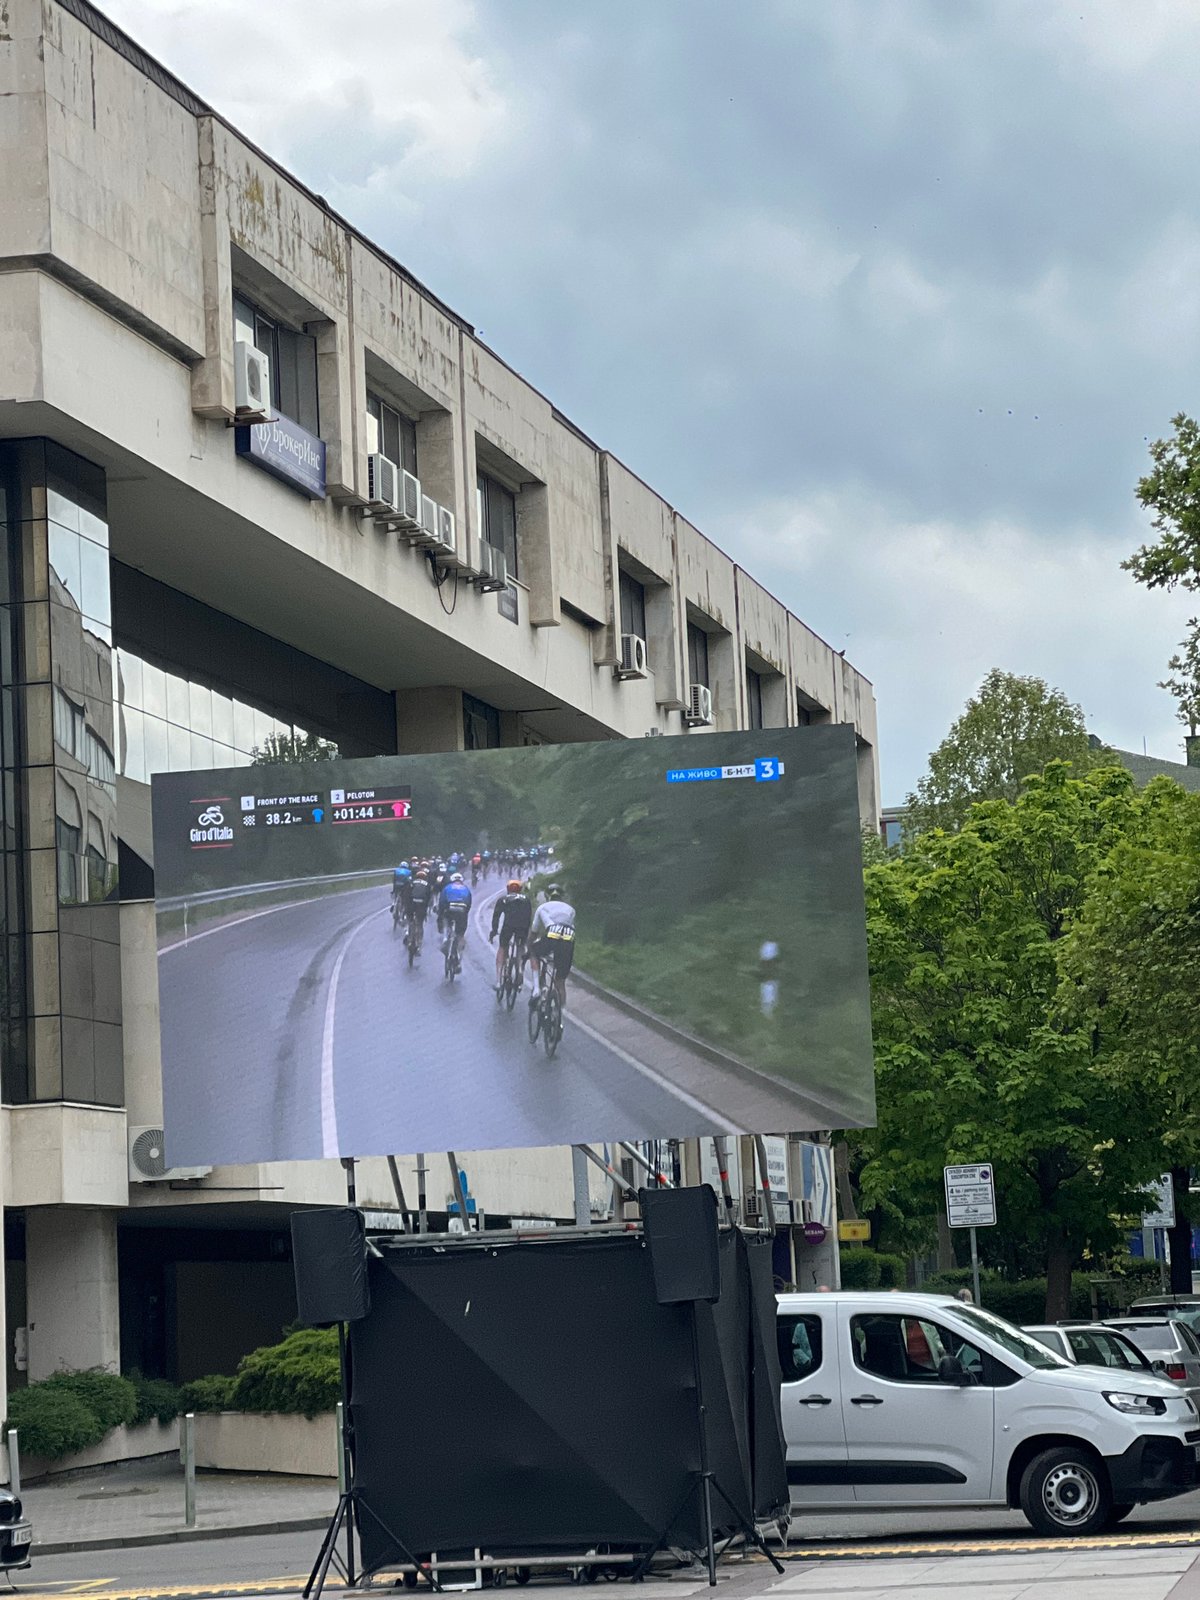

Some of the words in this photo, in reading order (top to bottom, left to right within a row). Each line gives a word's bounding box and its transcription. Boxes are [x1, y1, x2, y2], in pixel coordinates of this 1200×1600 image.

[671, 771, 685, 780] НА
[687, 769, 718, 779] ЖИВО
[760, 761, 775, 778] 3
[257, 798, 278, 806] FRONT
[278, 797, 287, 805] OF
[288, 796, 301, 804] THE
[301, 794, 318, 803] RACE
[346, 791, 375, 800] PELOTON
[265, 812, 291, 825] 38.2
[333, 806, 374, 819] +01:44
[190, 828, 207, 842] Giro
[207, 826, 234, 841] d'Italia
